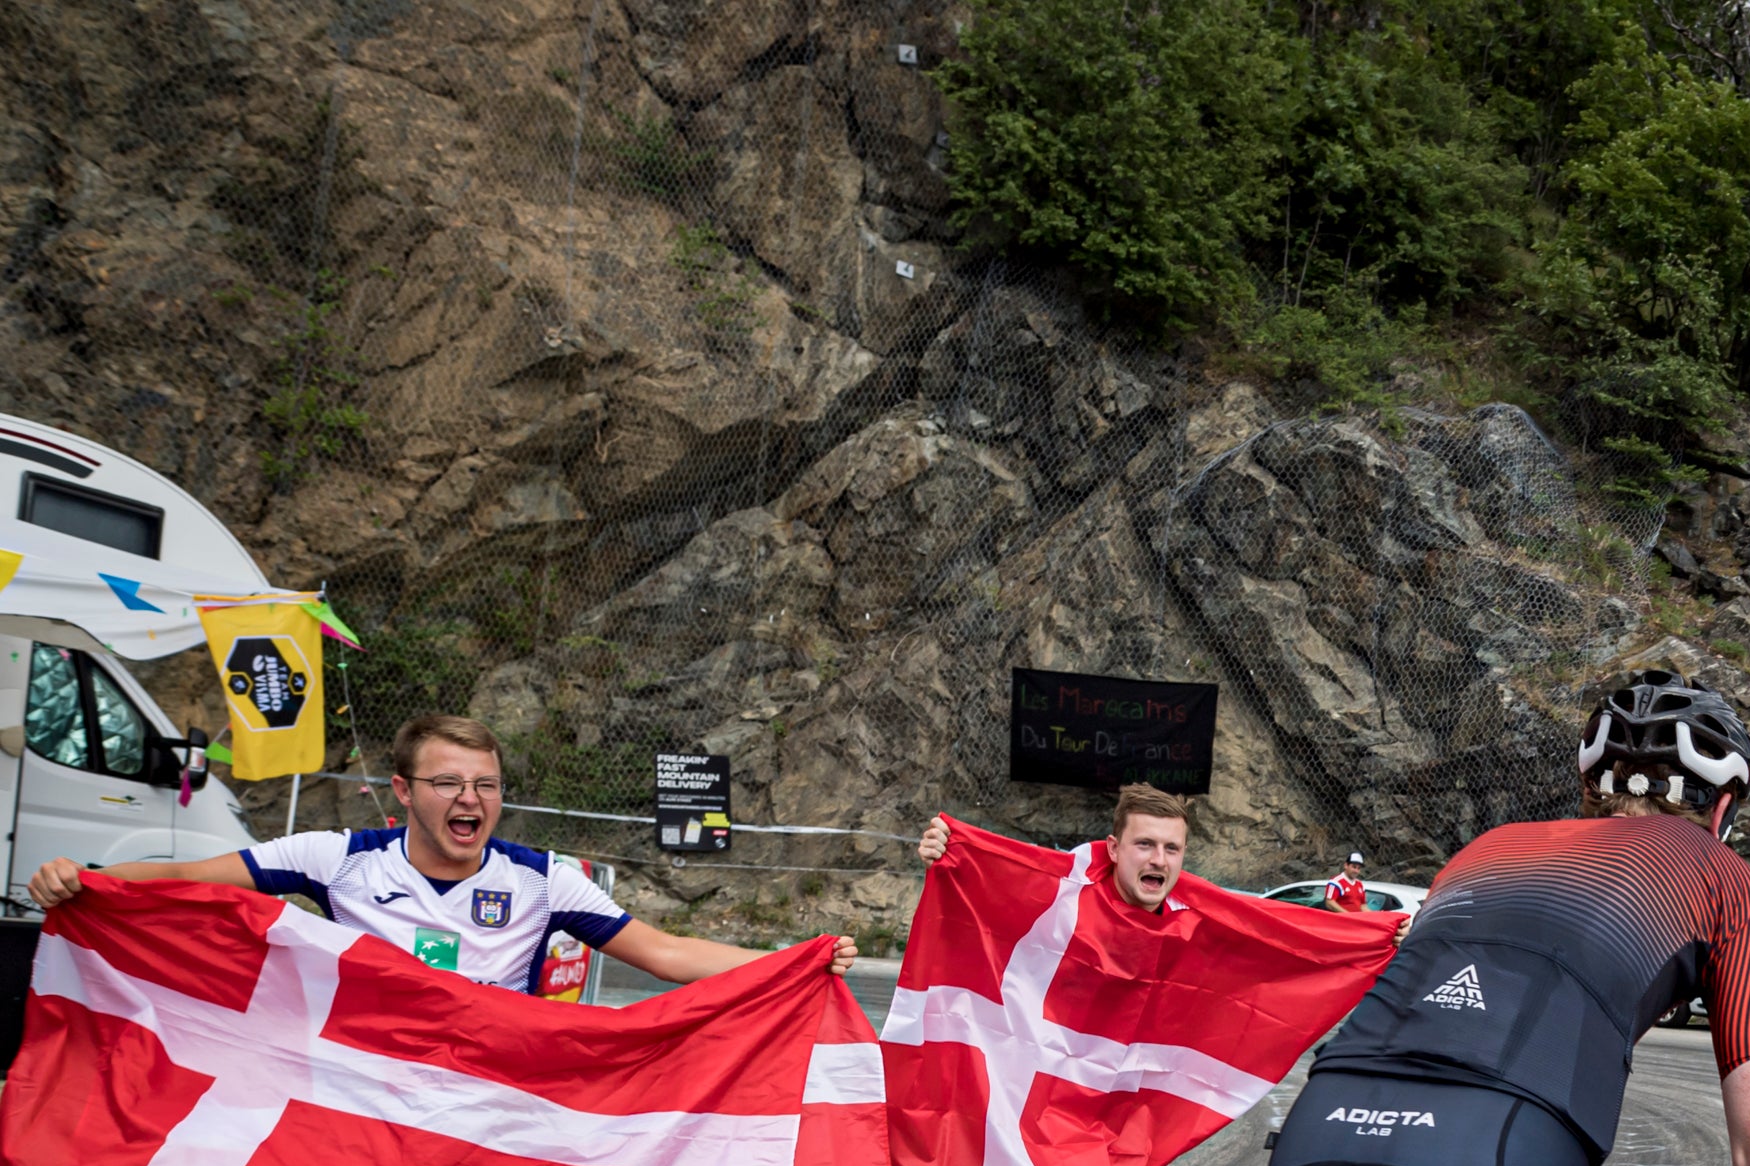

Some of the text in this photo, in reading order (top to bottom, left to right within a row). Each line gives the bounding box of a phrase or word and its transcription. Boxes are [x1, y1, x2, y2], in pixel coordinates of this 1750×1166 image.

[264, 655, 283, 711] JUMBO
[279, 666, 290, 700] TEAM
[254, 675, 271, 712] VISMA
[1020, 683, 1049, 711] Les
[1021, 724, 1193, 761] Du Tour De France
[657, 754, 710, 765] FREAKIN'
[657, 763, 687, 772] FAST
[657, 771, 720, 782] MOUNTAIN
[657, 780, 712, 790] DELIVERY
[1422, 994, 1487, 1010] ADICTA
[1325, 1107, 1435, 1127] ADICTA
[1355, 1126, 1392, 1136] LAB
